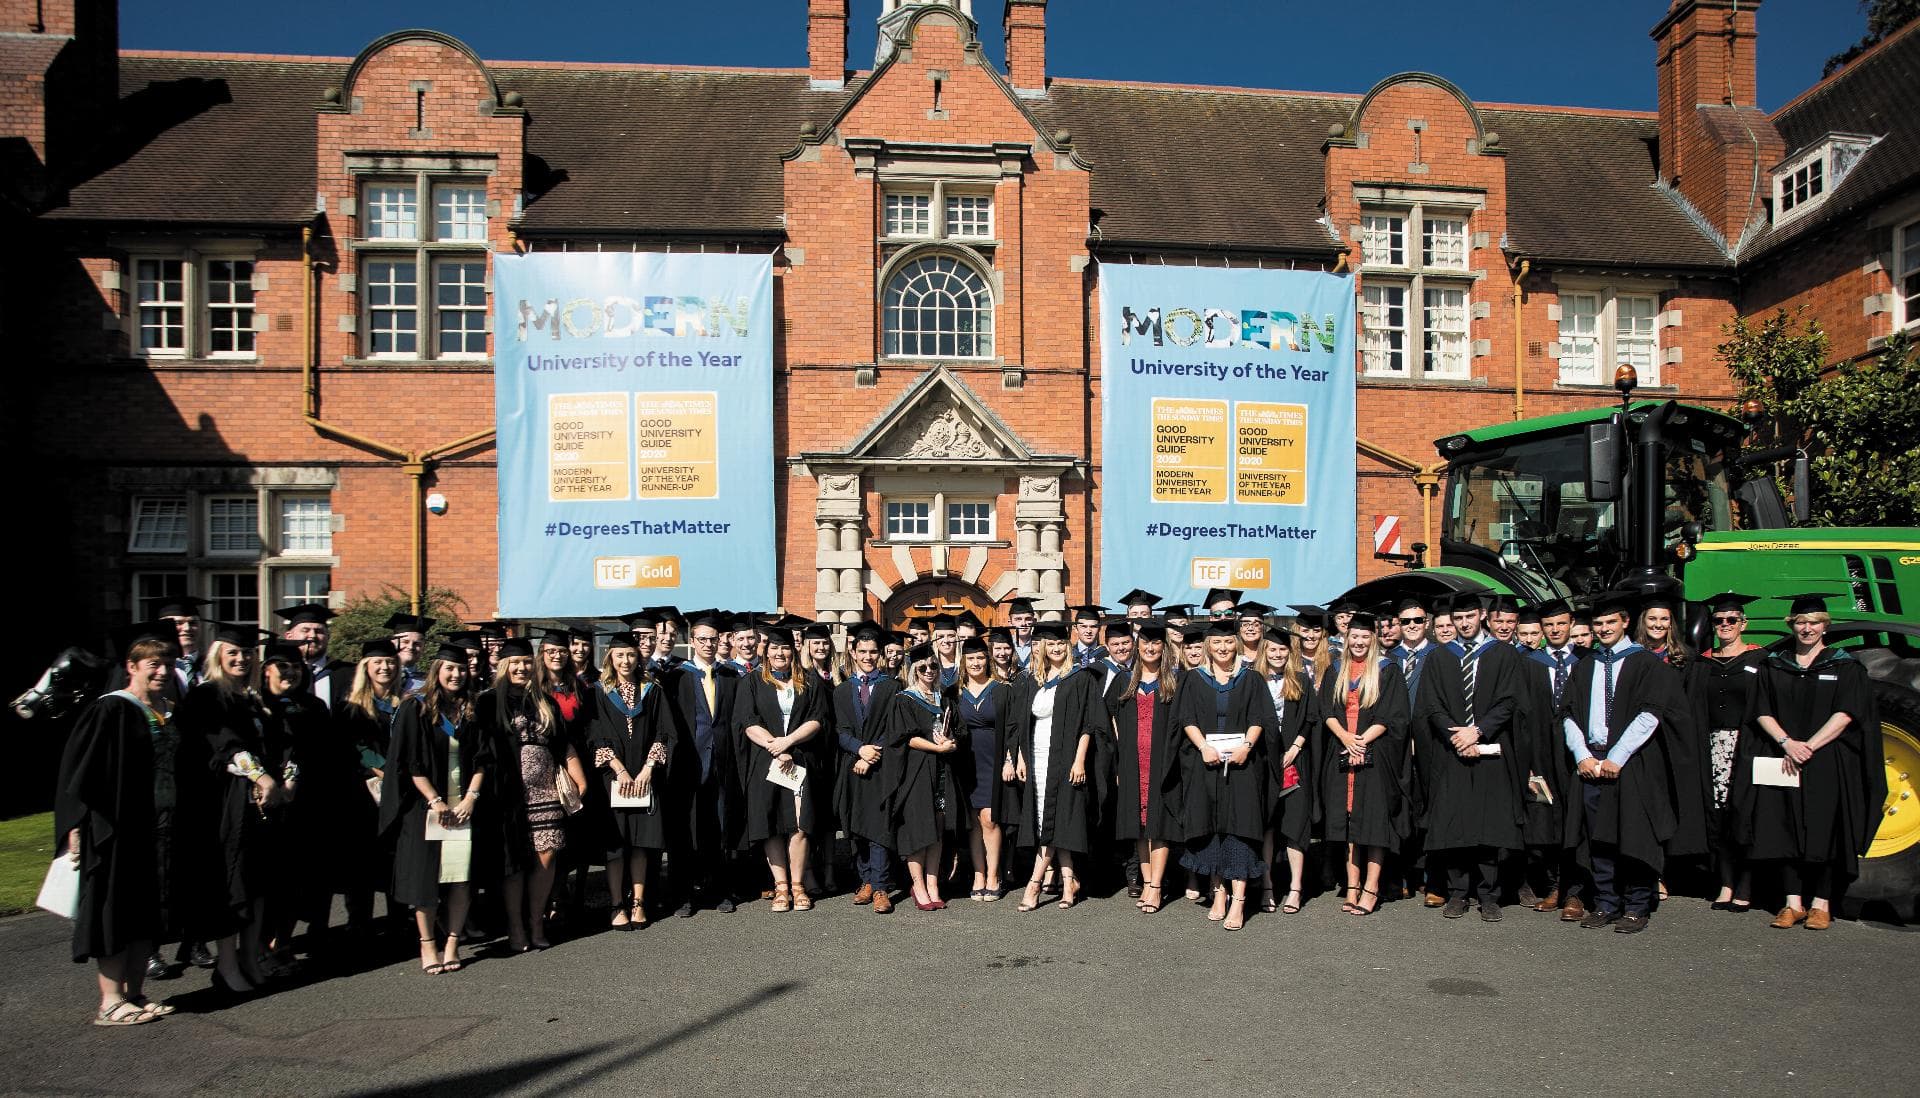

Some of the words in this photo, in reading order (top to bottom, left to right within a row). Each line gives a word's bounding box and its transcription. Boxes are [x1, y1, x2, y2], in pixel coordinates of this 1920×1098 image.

[517, 296, 749, 341] MODERN
[1121, 306, 1335, 353] MODERN
[528, 353, 629, 372] University
[633, 352, 658, 369] of
[660, 352, 692, 368] the
[698, 351, 742, 368] Year
[1131, 358, 1229, 381] University
[1233, 363, 1253, 378] of
[1256, 363, 1287, 380] the
[1290, 365, 1329, 382] Year
[1156, 406, 1174, 414] THE
[1196, 407, 1224, 415] TIMES
[1240, 409, 1258, 417] THE
[1280, 411, 1303, 419] TIMES
[640, 419, 672, 428] GOOD
[1255, 417, 1282, 425] SUNDAY
[1283, 418, 1303, 426] TIMES
[553, 422, 584, 431] GOOD
[1156, 425, 1187, 434] GOOD
[553, 431, 614, 440] UNIVERSITY
[640, 429, 702, 438] UNIVERSITY
[1239, 427, 1268, 436] GOOD
[640, 439, 672, 448] GUIDE
[1156, 435, 1215, 444] UNIVERSITY
[1239, 437, 1294, 447] UNIVERSITY
[553, 441, 585, 450] GUIDE
[1156, 445, 1187, 454] GUIDE
[640, 450, 666, 459] 2020
[1239, 447, 1268, 456] GUIDE
[1156, 455, 1182, 464] 2020
[1239, 456, 1263, 465] 2020
[553, 467, 592, 476] MODERN
[641, 466, 695, 474] UNIVERSITY
[1156, 470, 1194, 478] MODERN
[553, 476, 607, 484] UNIVERSITY
[641, 475, 653, 483] OF
[674, 474, 700, 482] YEAR
[1239, 473, 1287, 481] UNIVERSITY
[641, 483, 694, 491] RUNNER-UP
[1156, 479, 1208, 487] UNIVERSITY
[1239, 481, 1250, 489] OF
[1251, 481, 1268, 489] THE
[1269, 482, 1291, 490] YEAR
[554, 485, 566, 493] OF
[567, 485, 585, 493] THE
[587, 484, 612, 492] YEAR
[1156, 487, 1167, 495] OF
[1169, 487, 1186, 495] THE
[1239, 489, 1286, 497] RUNNER-UP
[545, 520, 731, 540] #DegreesThatMatter
[1145, 522, 1317, 541] #DegreesThatMatter
[601, 565, 631, 580] TEF
[641, 565, 673, 579] Gold
[1198, 565, 1226, 580] TEF
[1235, 567, 1264, 580] Gold
